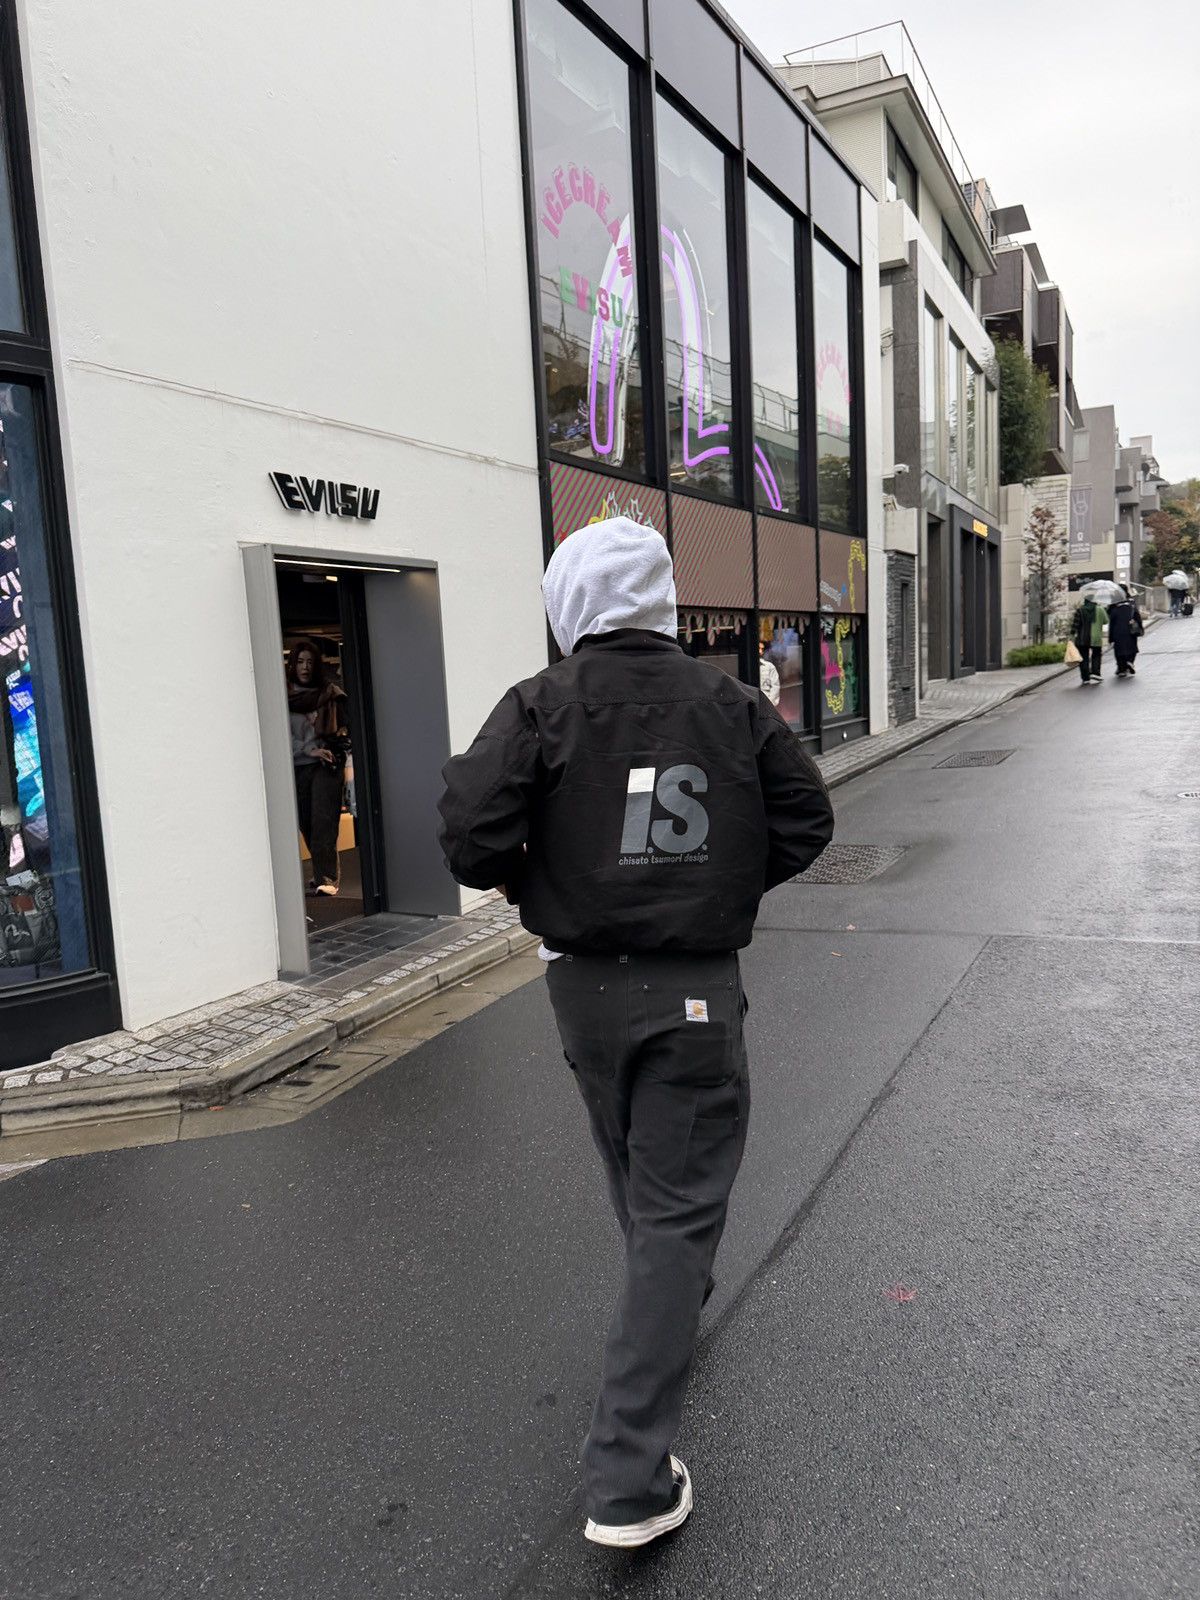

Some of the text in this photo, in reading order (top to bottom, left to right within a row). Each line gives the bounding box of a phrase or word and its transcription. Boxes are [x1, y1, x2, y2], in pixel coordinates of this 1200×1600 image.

[559, 266, 624, 328] EVISU
[268, 471, 380, 520] EVISU
[684, 852, 709, 864] design
